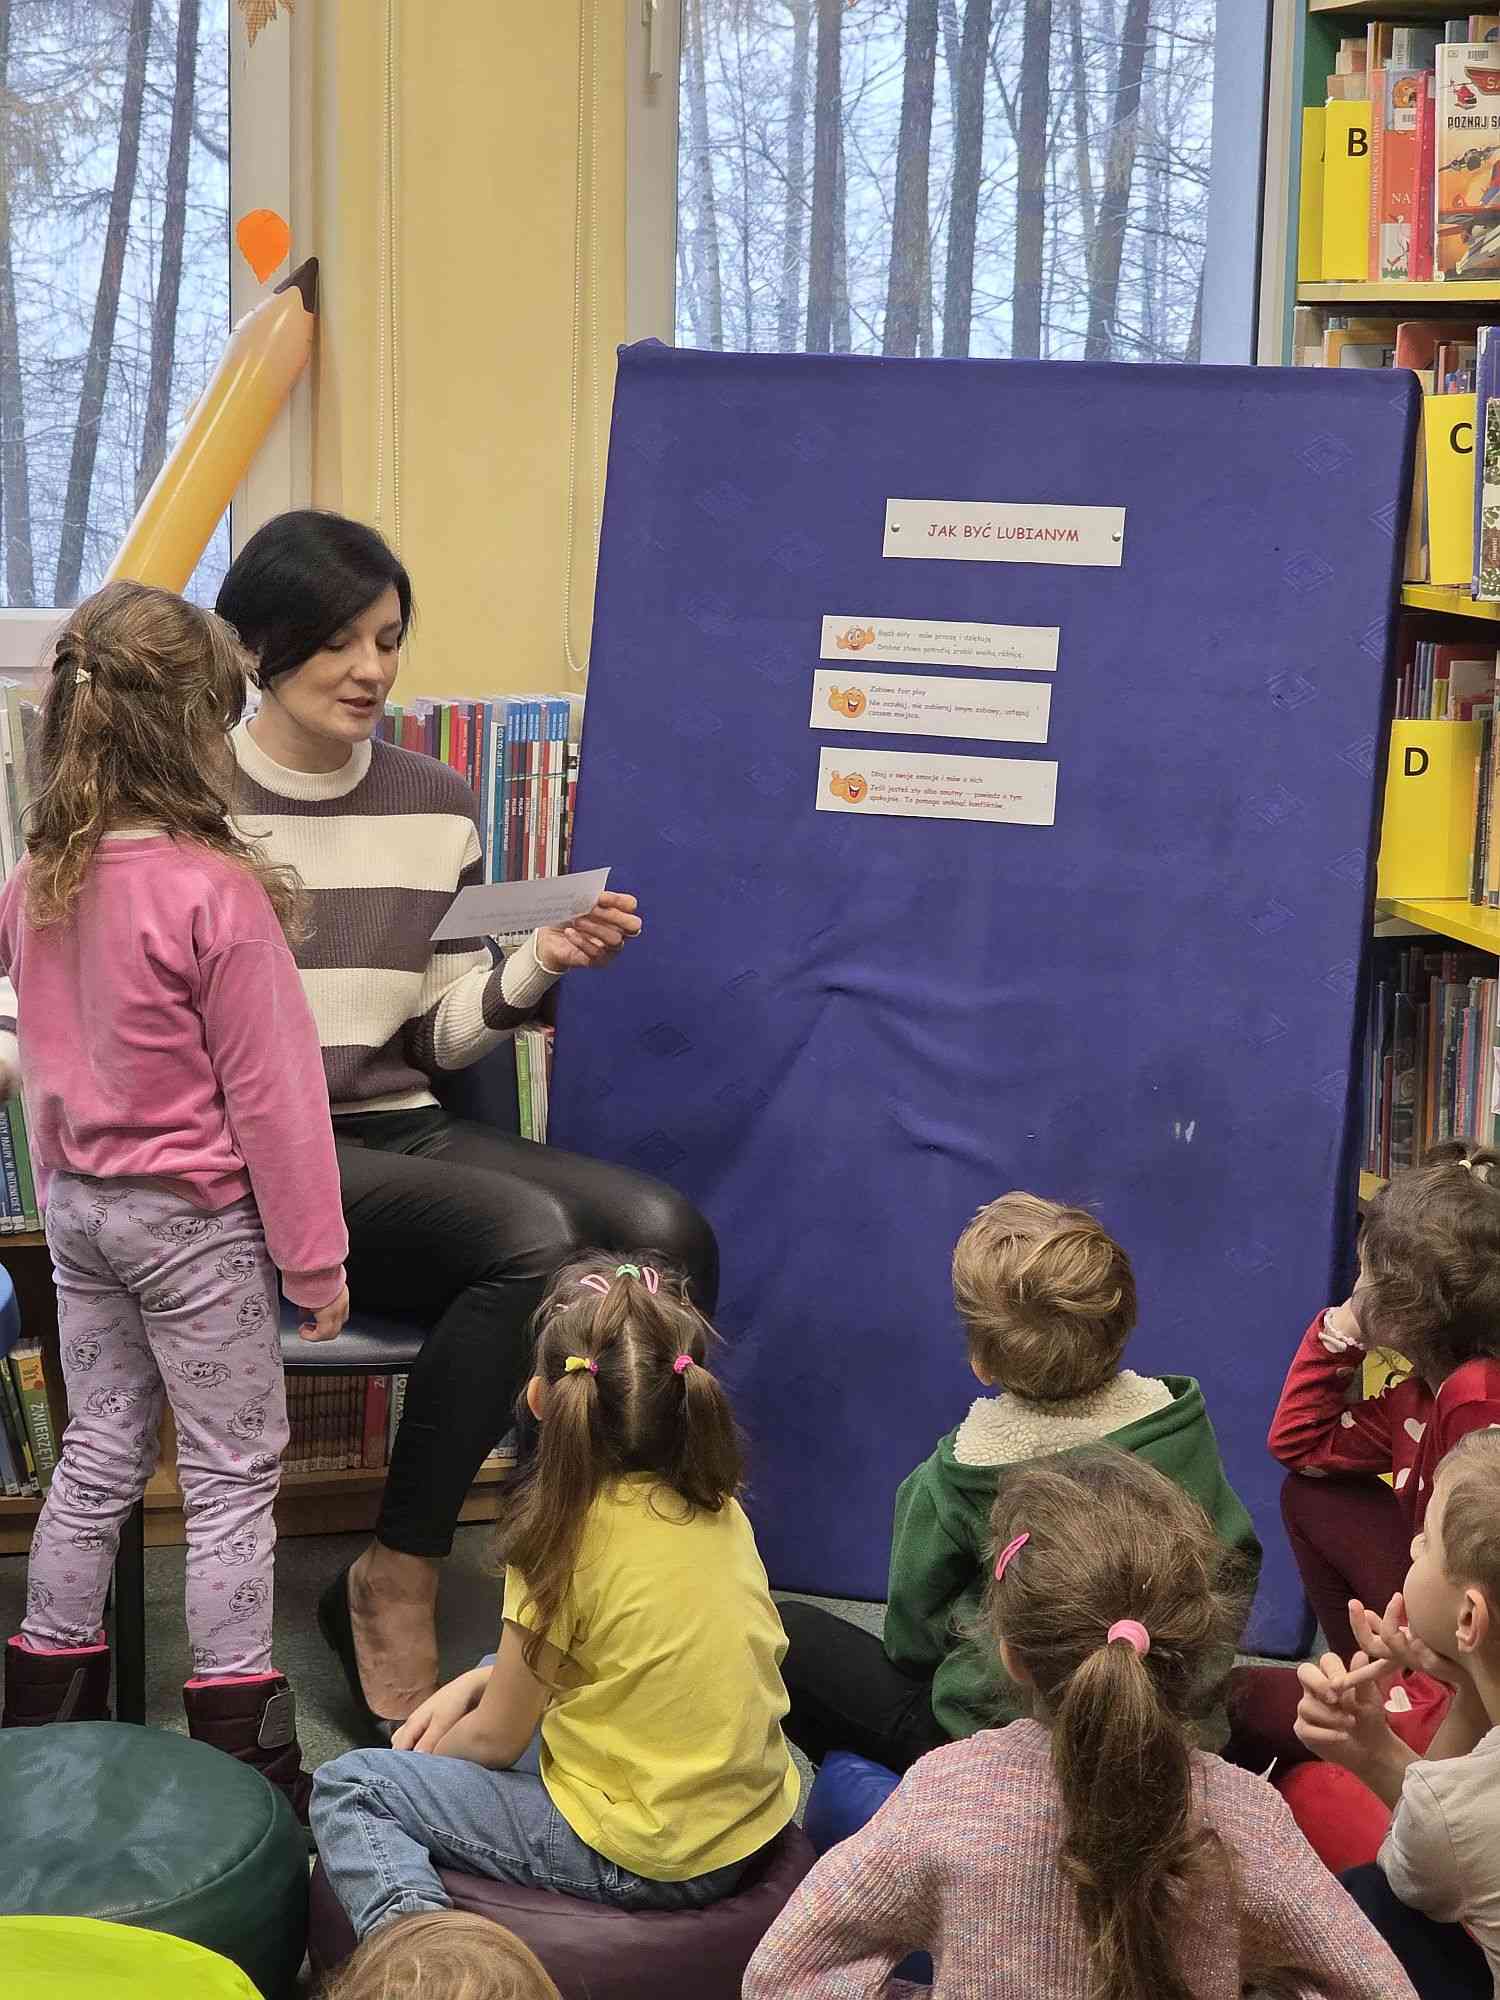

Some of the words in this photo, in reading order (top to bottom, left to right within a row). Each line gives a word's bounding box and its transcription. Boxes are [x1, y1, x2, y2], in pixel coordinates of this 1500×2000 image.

[1486, 75, 1500, 90] S
[1447, 115, 1488, 129] POZNAJ
[1347, 127, 1369, 157] B
[1449, 422, 1473, 454] C
[927, 524, 957, 538] JAK
[963, 521, 992, 539] BYĆ
[996, 526, 1080, 542] LUBIANYM
[1403, 747, 1430, 777] D
